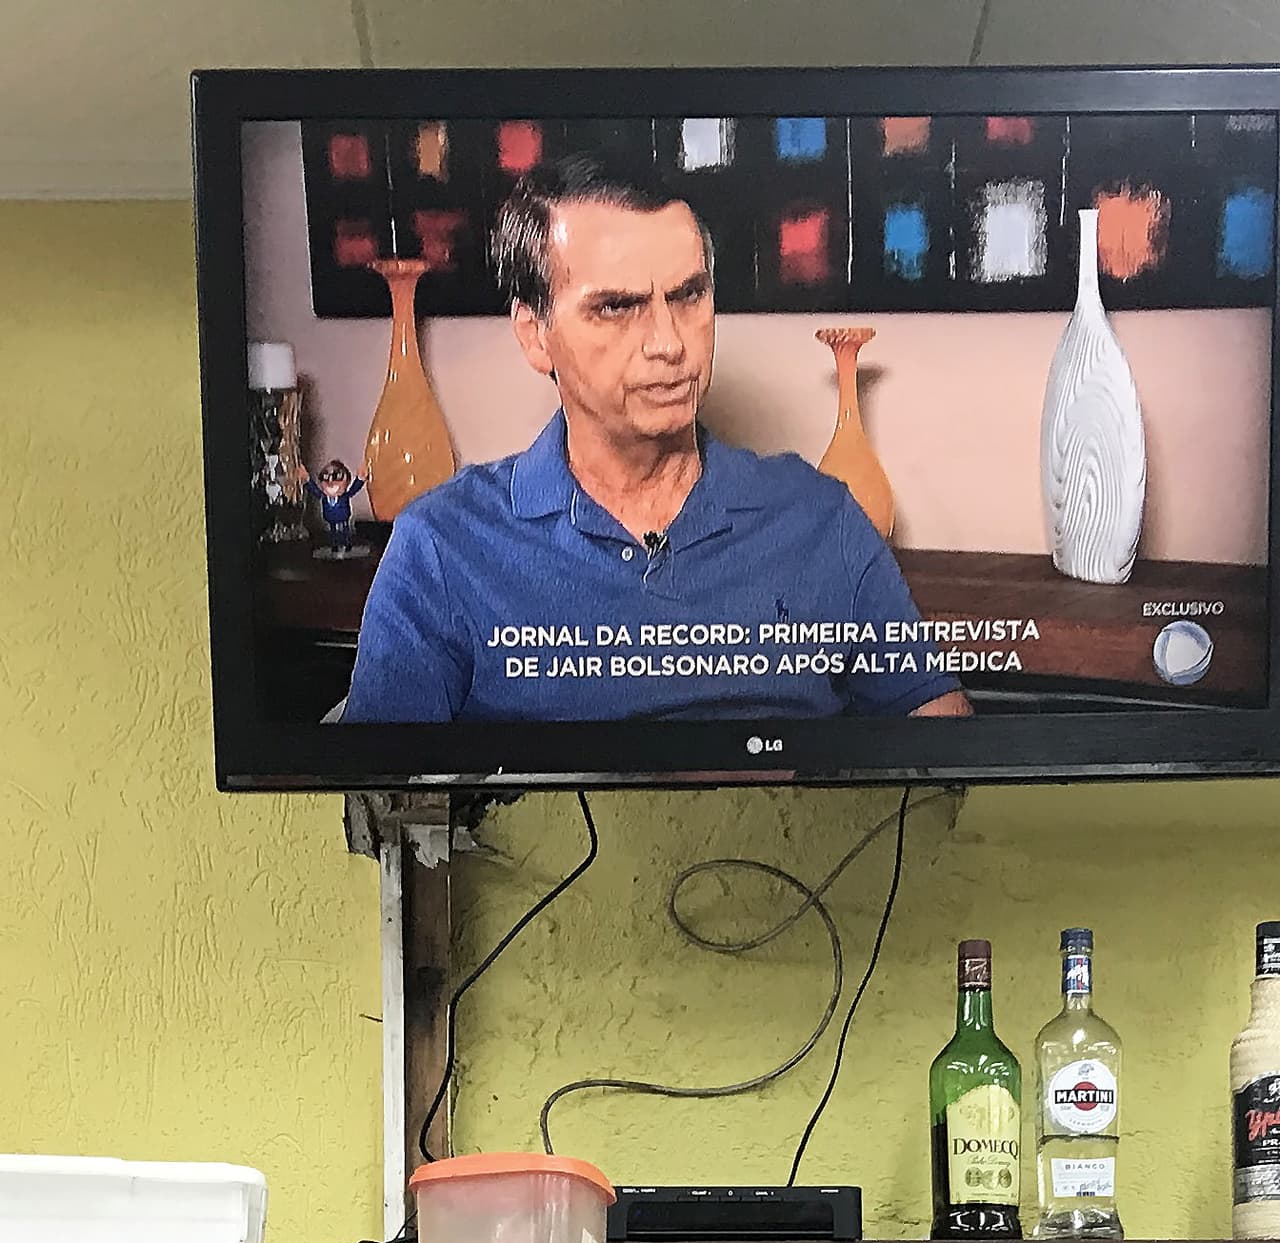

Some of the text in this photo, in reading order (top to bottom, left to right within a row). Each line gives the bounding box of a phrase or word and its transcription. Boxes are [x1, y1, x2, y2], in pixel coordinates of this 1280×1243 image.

[1142, 601, 1225, 616] EXCLUSIVO
[487, 619, 1040, 648] JORNAL DA RECORD: PRIMEIRA ENTREVISTA
[505, 646, 1023, 678] DE JAIR BOLSONARO APÓS ALTA MÉDICA
[765, 739, 783, 752] LG
[1056, 1090, 1114, 1103] MARTINI
[953, 1138, 1018, 1160] DOMECQ
